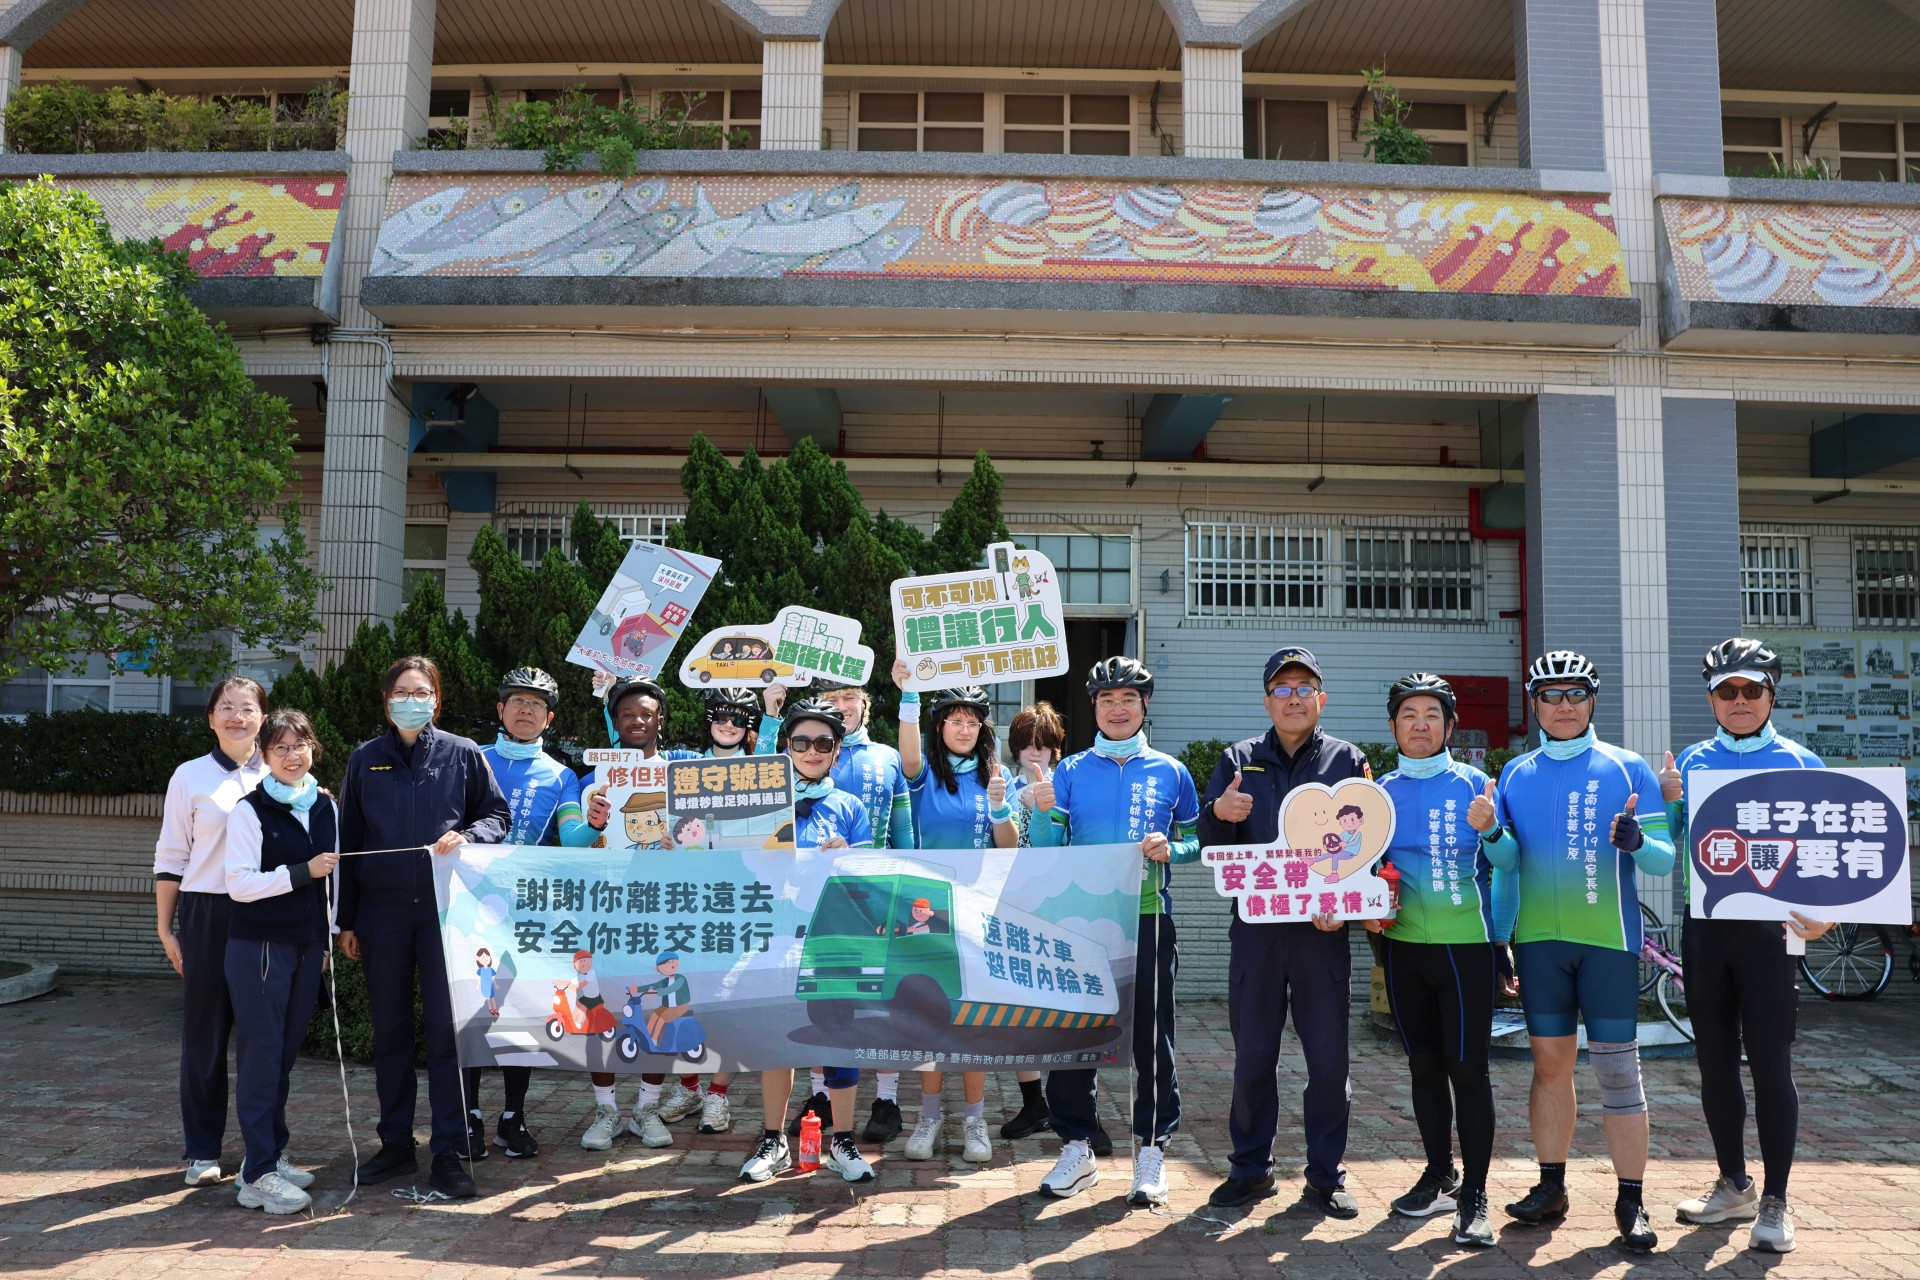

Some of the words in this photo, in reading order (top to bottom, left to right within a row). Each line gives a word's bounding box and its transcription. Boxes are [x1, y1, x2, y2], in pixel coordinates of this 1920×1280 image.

[900, 577, 997, 610] 可不可以
[663, 610, 680, 623] 危險
[904, 602, 1057, 654] 禮讓行人
[775, 640, 867, 682] 酒後代駕
[939, 644, 1059, 677] 一下下就好
[588, 751, 639, 763] 路口到了！
[673, 761, 787, 796] 遵守號誌
[674, 791, 787, 811] 綠燈秒數足夠再通過
[1735, 800, 1888, 834] 車子在走
[1221, 861, 1310, 891] 安全帶
[515, 877, 775, 915] 謝謝你離我遠去
[1246, 891, 1363, 917] 像極了愛情
[514, 919, 775, 955] 安全你我交錯行
[981, 911, 1075, 963] 遠離大車
[983, 950, 1105, 996] 避開內輪差
[854, 1047, 946, 1063] 交通部道安委員會
[950, 1052, 1035, 1065] 臺南市政府警察局
[1041, 1053, 1073, 1064] 關心您
[1079, 1052, 1098, 1062] 廣告
